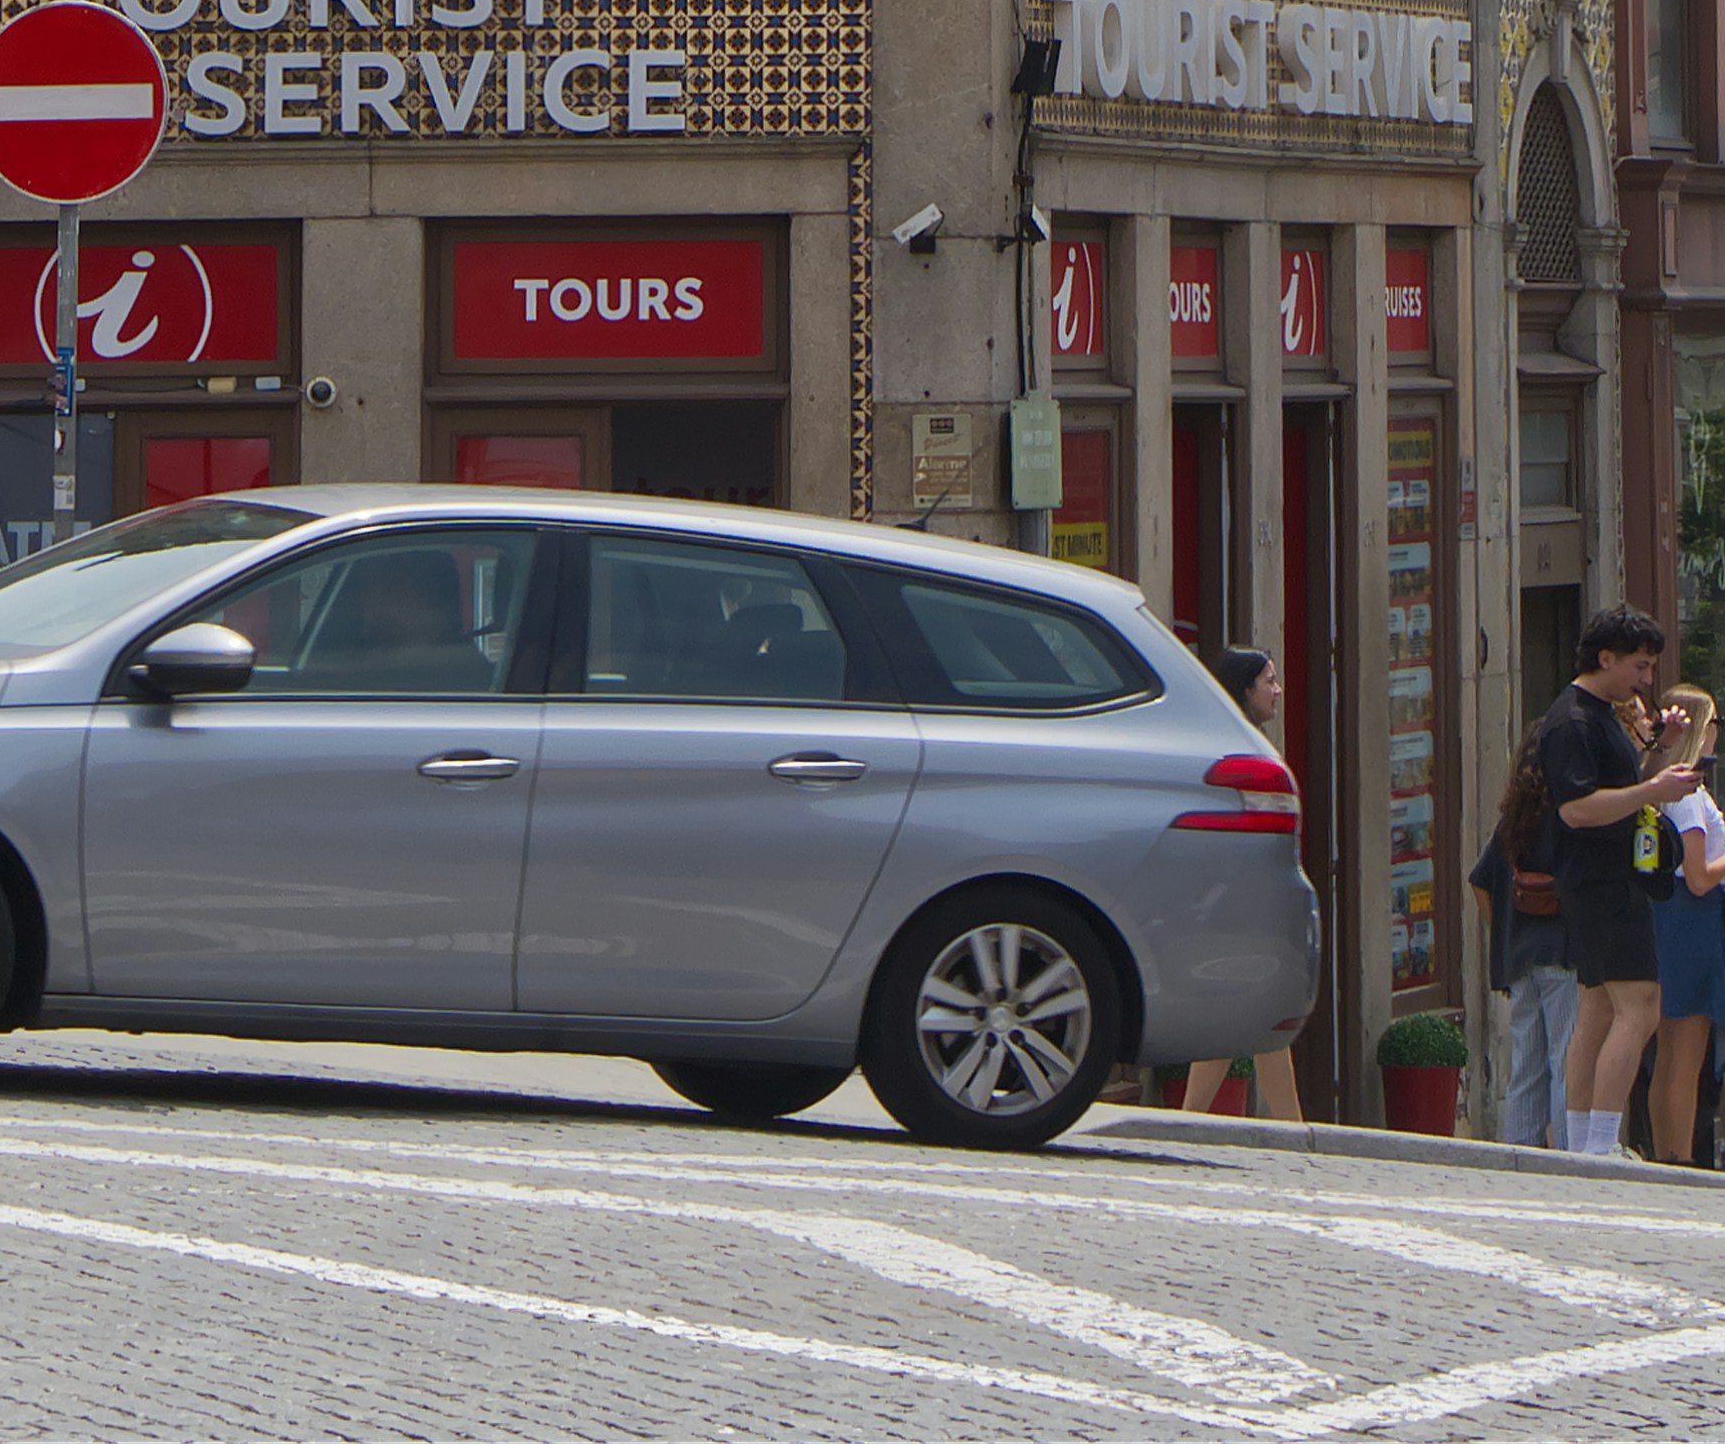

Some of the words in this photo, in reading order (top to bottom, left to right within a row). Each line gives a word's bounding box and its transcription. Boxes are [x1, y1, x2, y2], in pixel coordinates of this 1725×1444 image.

[184, 49, 686, 136] SERVICE
[1278, 4, 1473, 124] SERVICE
[513, 277, 704, 322] TOURS
